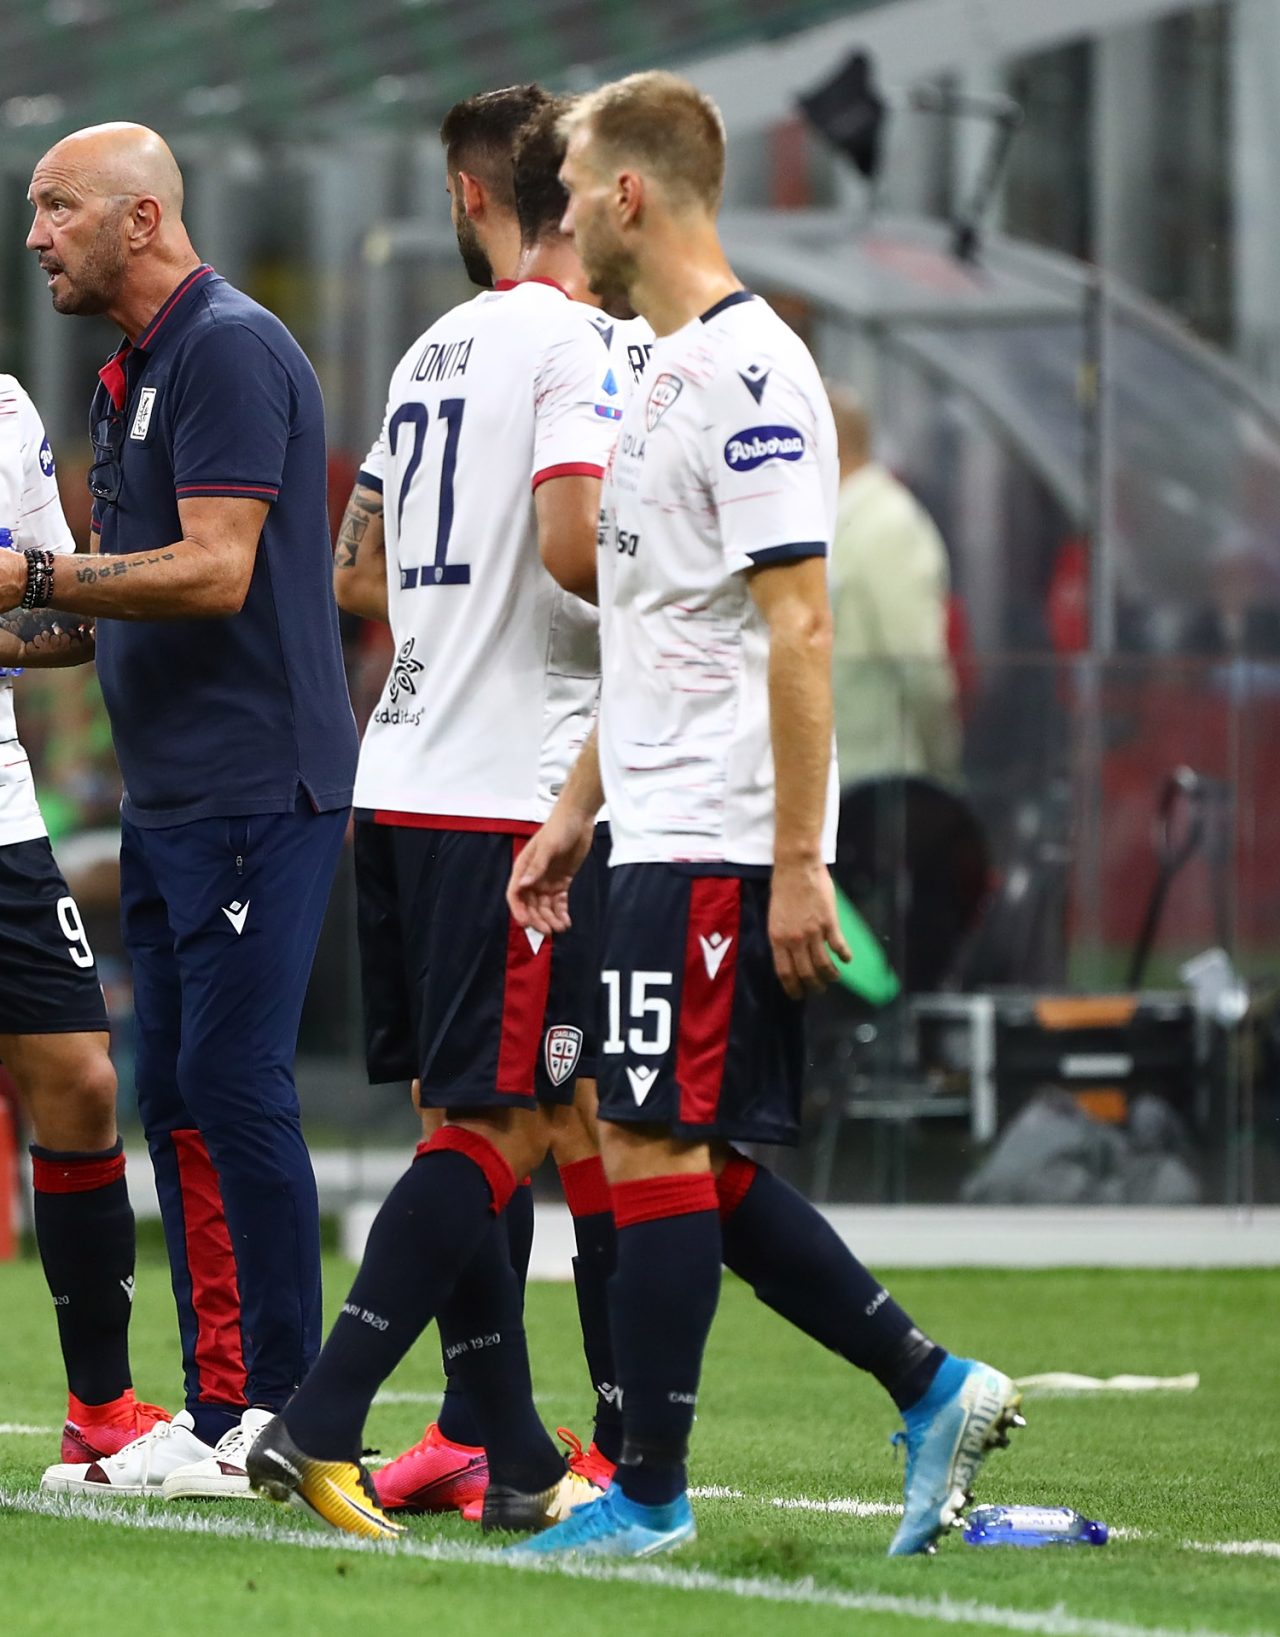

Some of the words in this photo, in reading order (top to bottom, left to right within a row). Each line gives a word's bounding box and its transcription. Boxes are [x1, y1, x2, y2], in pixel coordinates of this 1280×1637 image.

[410, 336, 474, 382] IONITA
[727, 436, 804, 464] Arborea
[388, 397, 471, 590] 21
[56, 896, 95, 968] 9
[601, 969, 673, 1055] 15
[361, 1309, 390, 1331] 1920
[470, 1332, 501, 1350] 1920
